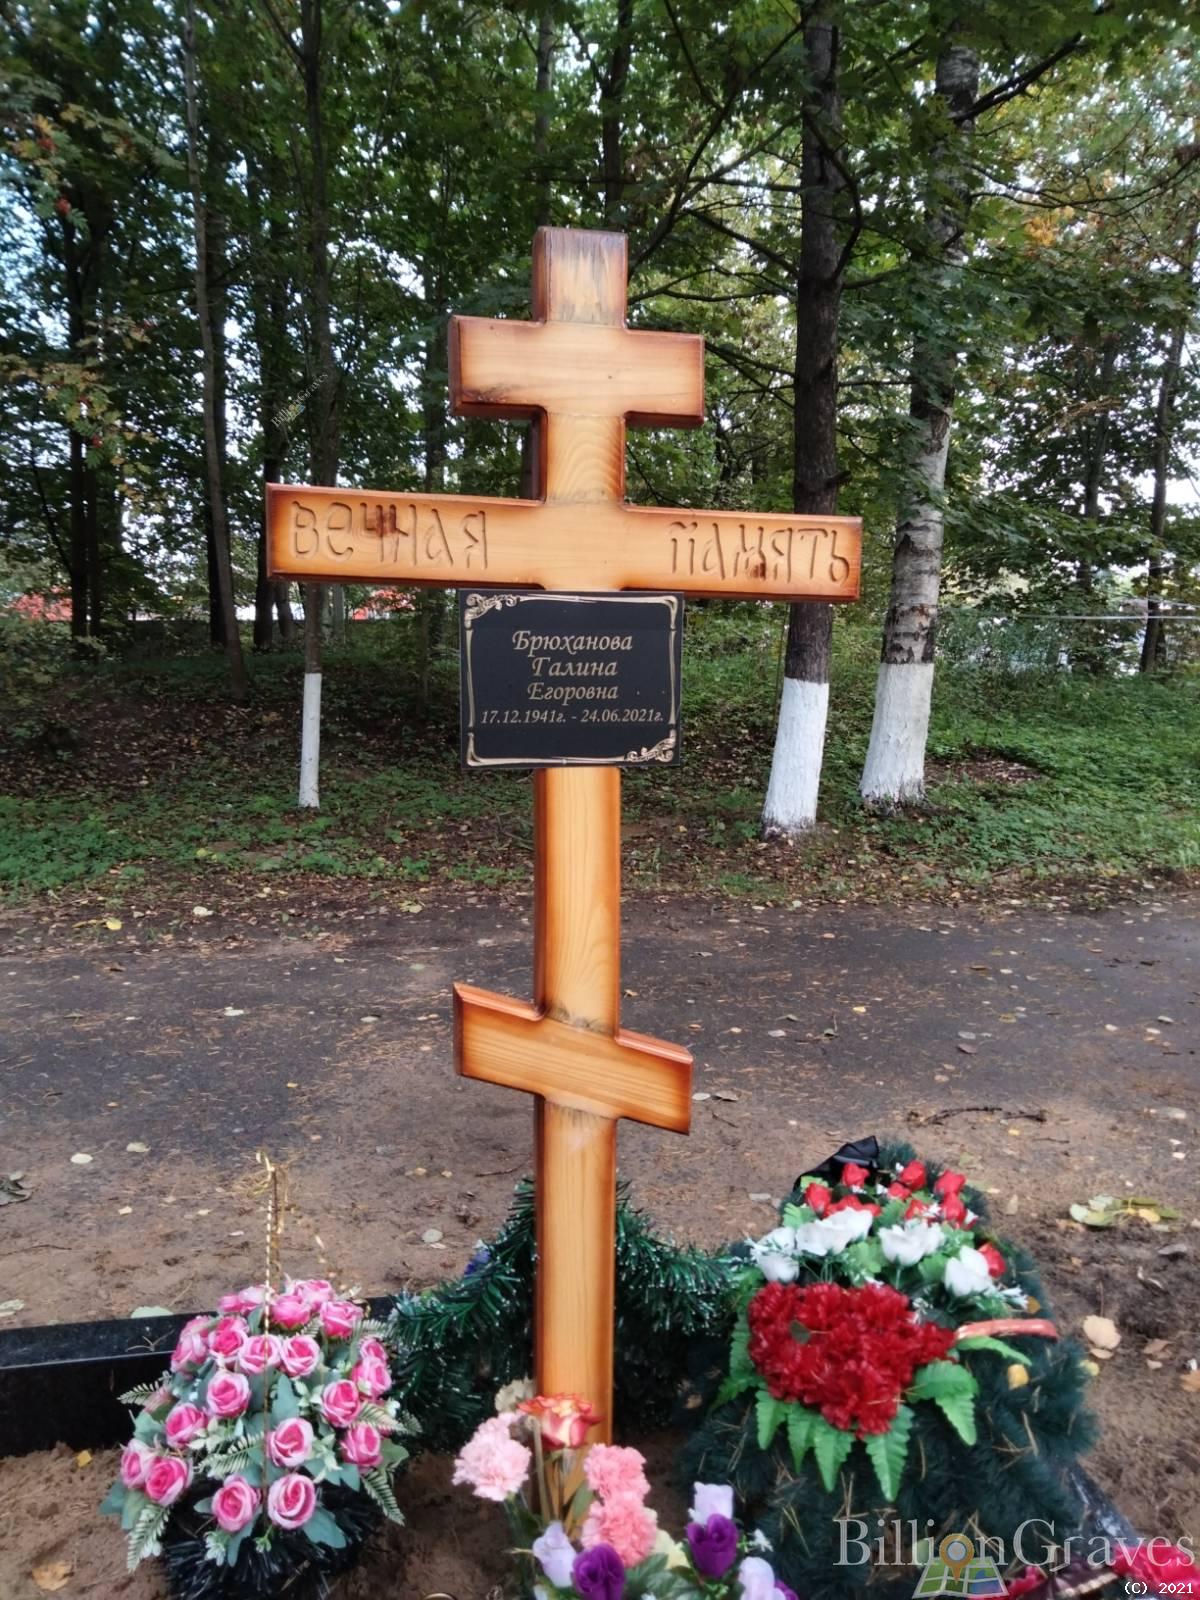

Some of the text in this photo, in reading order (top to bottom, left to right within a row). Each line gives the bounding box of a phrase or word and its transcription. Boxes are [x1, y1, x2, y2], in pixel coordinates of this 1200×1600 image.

[512, 630, 633, 657] Брюханова
[531, 656, 618, 677] Галина
[527, 682, 619, 705] Егоровна
[481, 710, 567, 724] 17.12.1941г.
[580, 709, 664, 723] 24.06.2021г.
